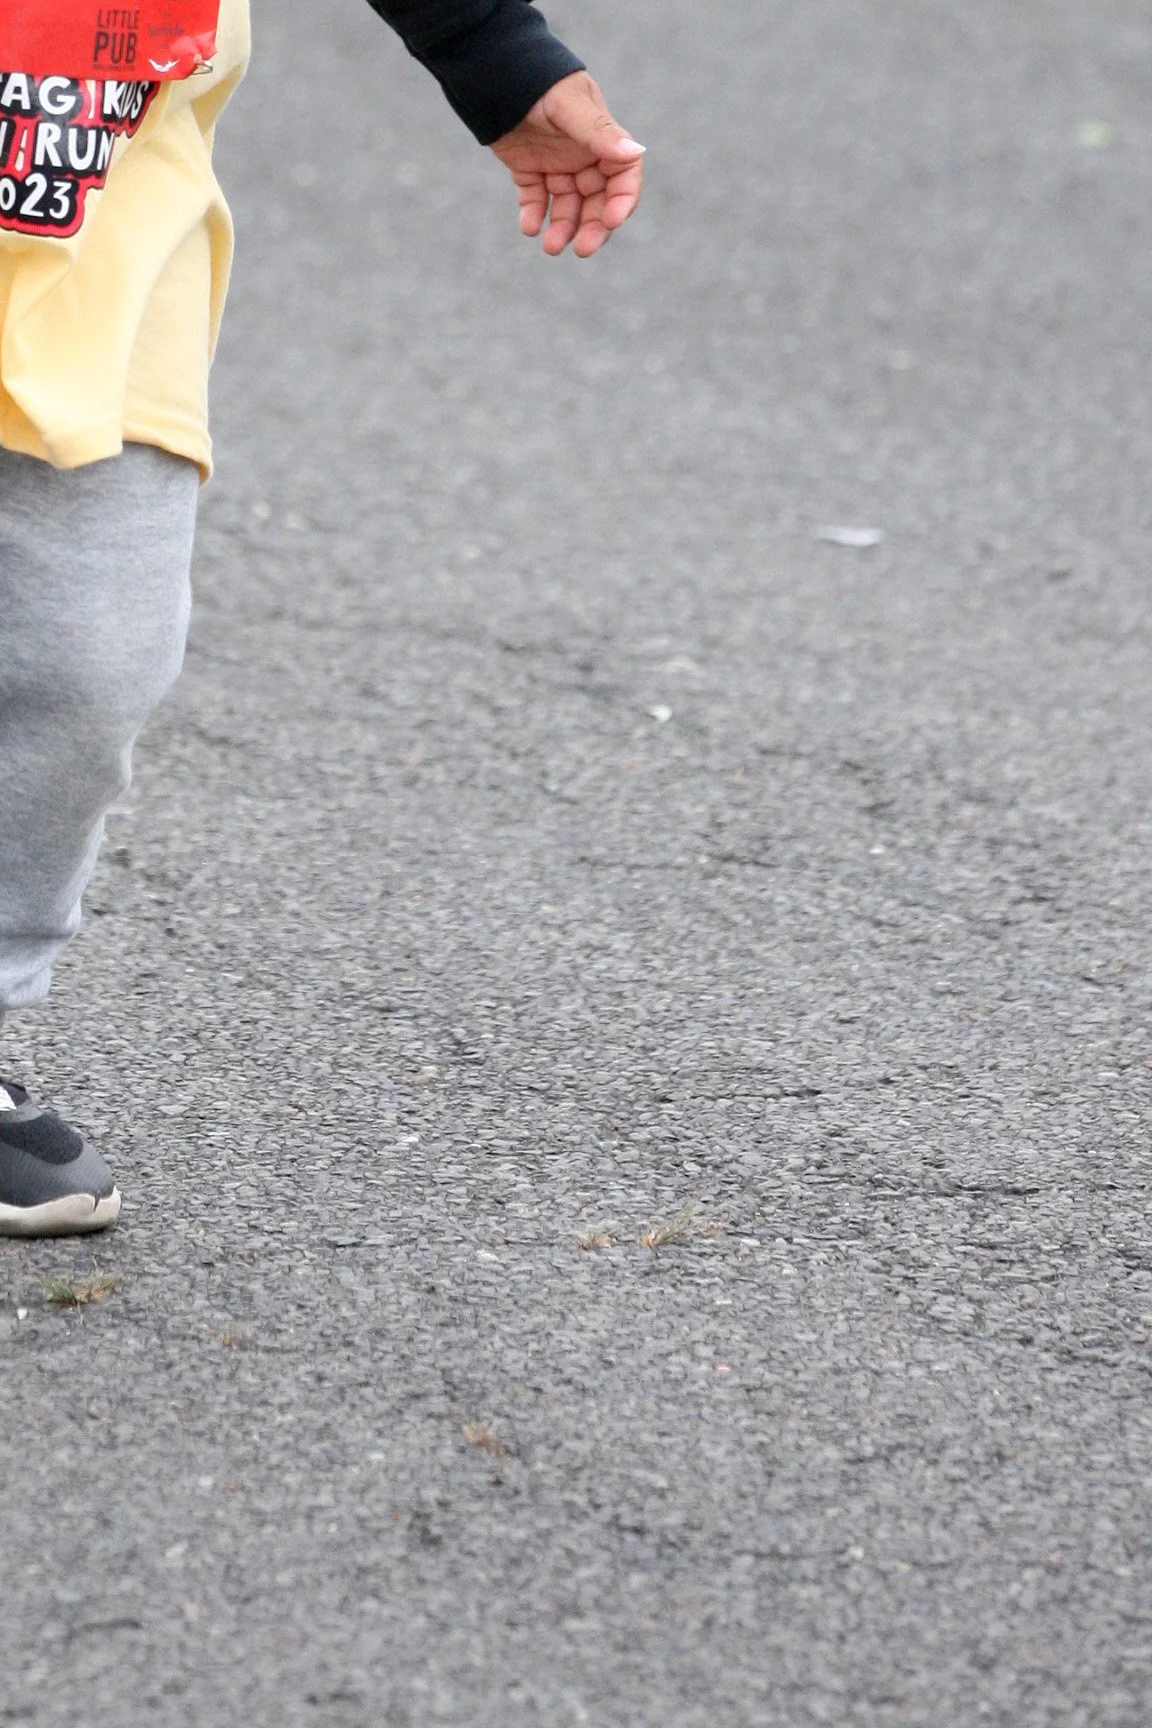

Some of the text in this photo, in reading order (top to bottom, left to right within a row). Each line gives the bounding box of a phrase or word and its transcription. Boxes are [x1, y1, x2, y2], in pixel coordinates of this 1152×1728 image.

[97, 9, 140, 29] LITTLE
[93, 31, 137, 64] PUB
[103, 80, 148, 120] KIDS
[35, 122, 115, 173] RUN
